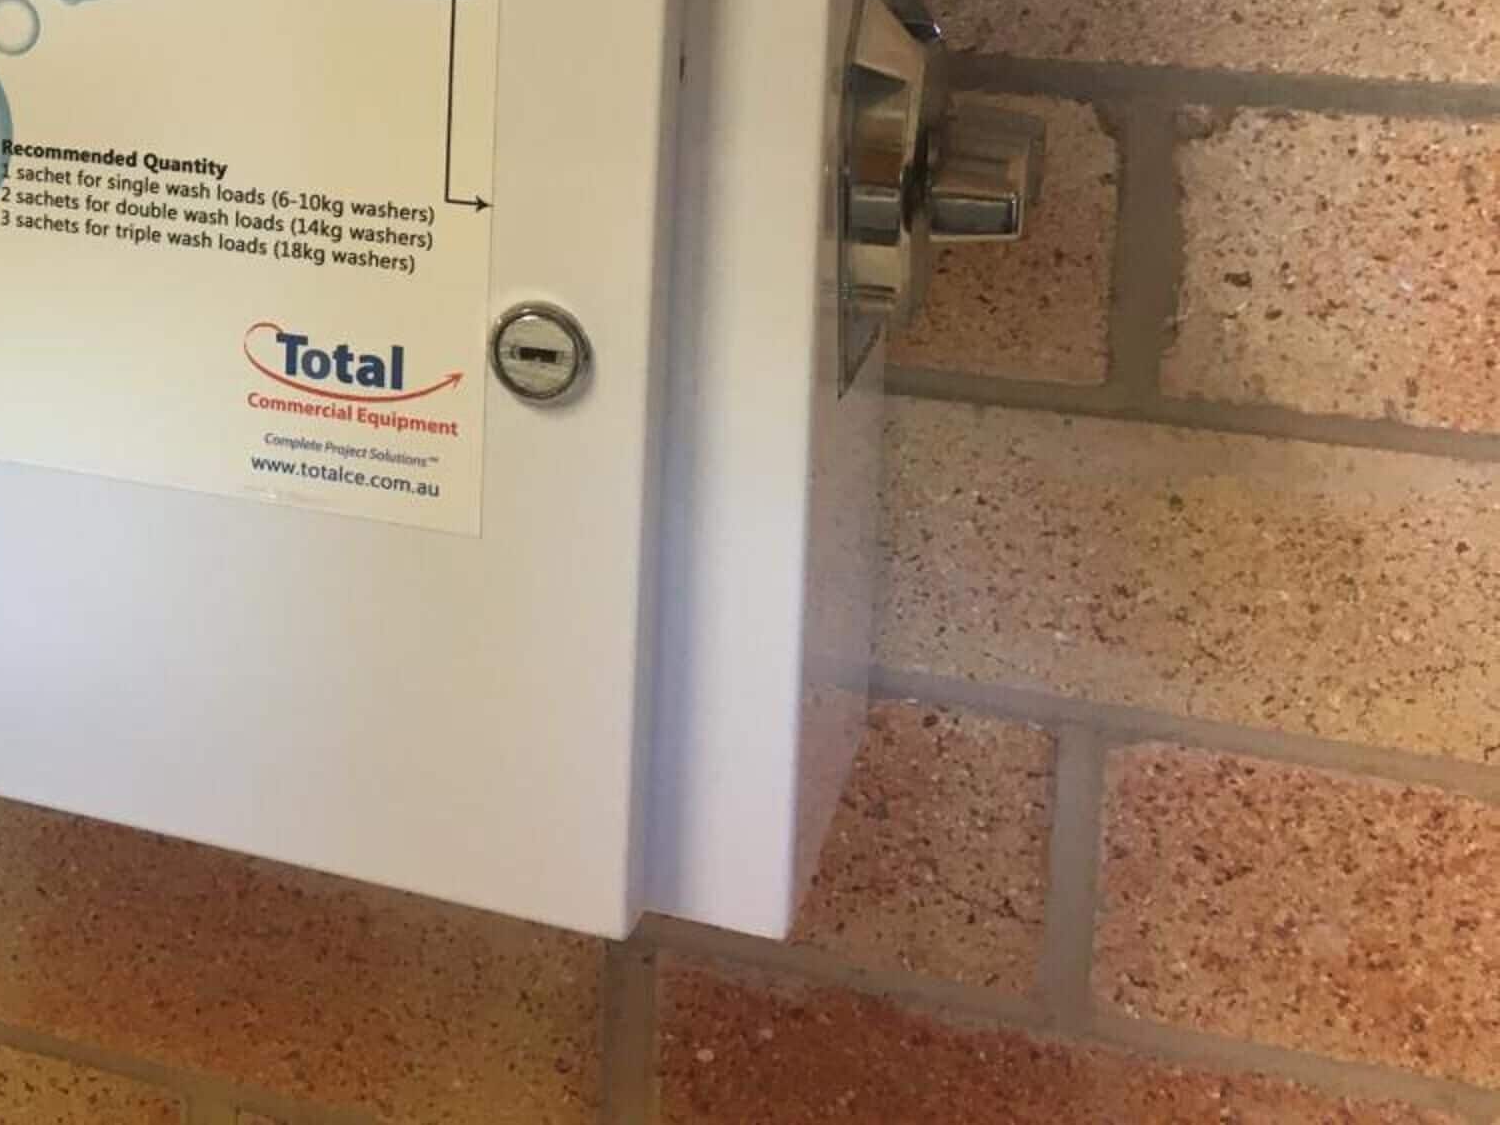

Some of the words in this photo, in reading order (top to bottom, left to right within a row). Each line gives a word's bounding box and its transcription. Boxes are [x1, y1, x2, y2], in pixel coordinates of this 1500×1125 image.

[1, 139, 138, 167] Recommended
[143, 153, 228, 180] Quantity
[1, 187, 11, 203] 2
[16, 189, 79, 211] sachets
[85, 194, 110, 213] for
[116, 200, 178, 221] double
[184, 206, 229, 225] wash
[236, 211, 284, 232] loads
[291, 218, 343, 243] (14kg
[349, 225, 433, 251] washers)
[3, 163, 11, 178] 1
[16, 166, 71, 185] sachet
[77, 170, 102, 188] for
[107, 177, 160, 197] single
[166, 181, 211, 199] wash
[217, 185, 265, 205] loads
[351, 201, 435, 225] washers)
[1, 210, 11, 226] 3
[16, 213, 79, 234] sachets
[85, 218, 110, 237] for
[116, 224, 162, 244] triple
[167, 230, 213, 249] wash
[219, 234, 268, 255] loads
[273, 241, 325, 266] (18kg
[332, 250, 415, 274] washers)
[276, 332, 404, 391] Total
[248, 392, 353, 421] Commercial
[357, 407, 459, 436] Equipment
[264, 433, 323, 452] Complete
[325, 441, 368, 460] Project
[250, 455, 441, 497] www.totalce.com.au
